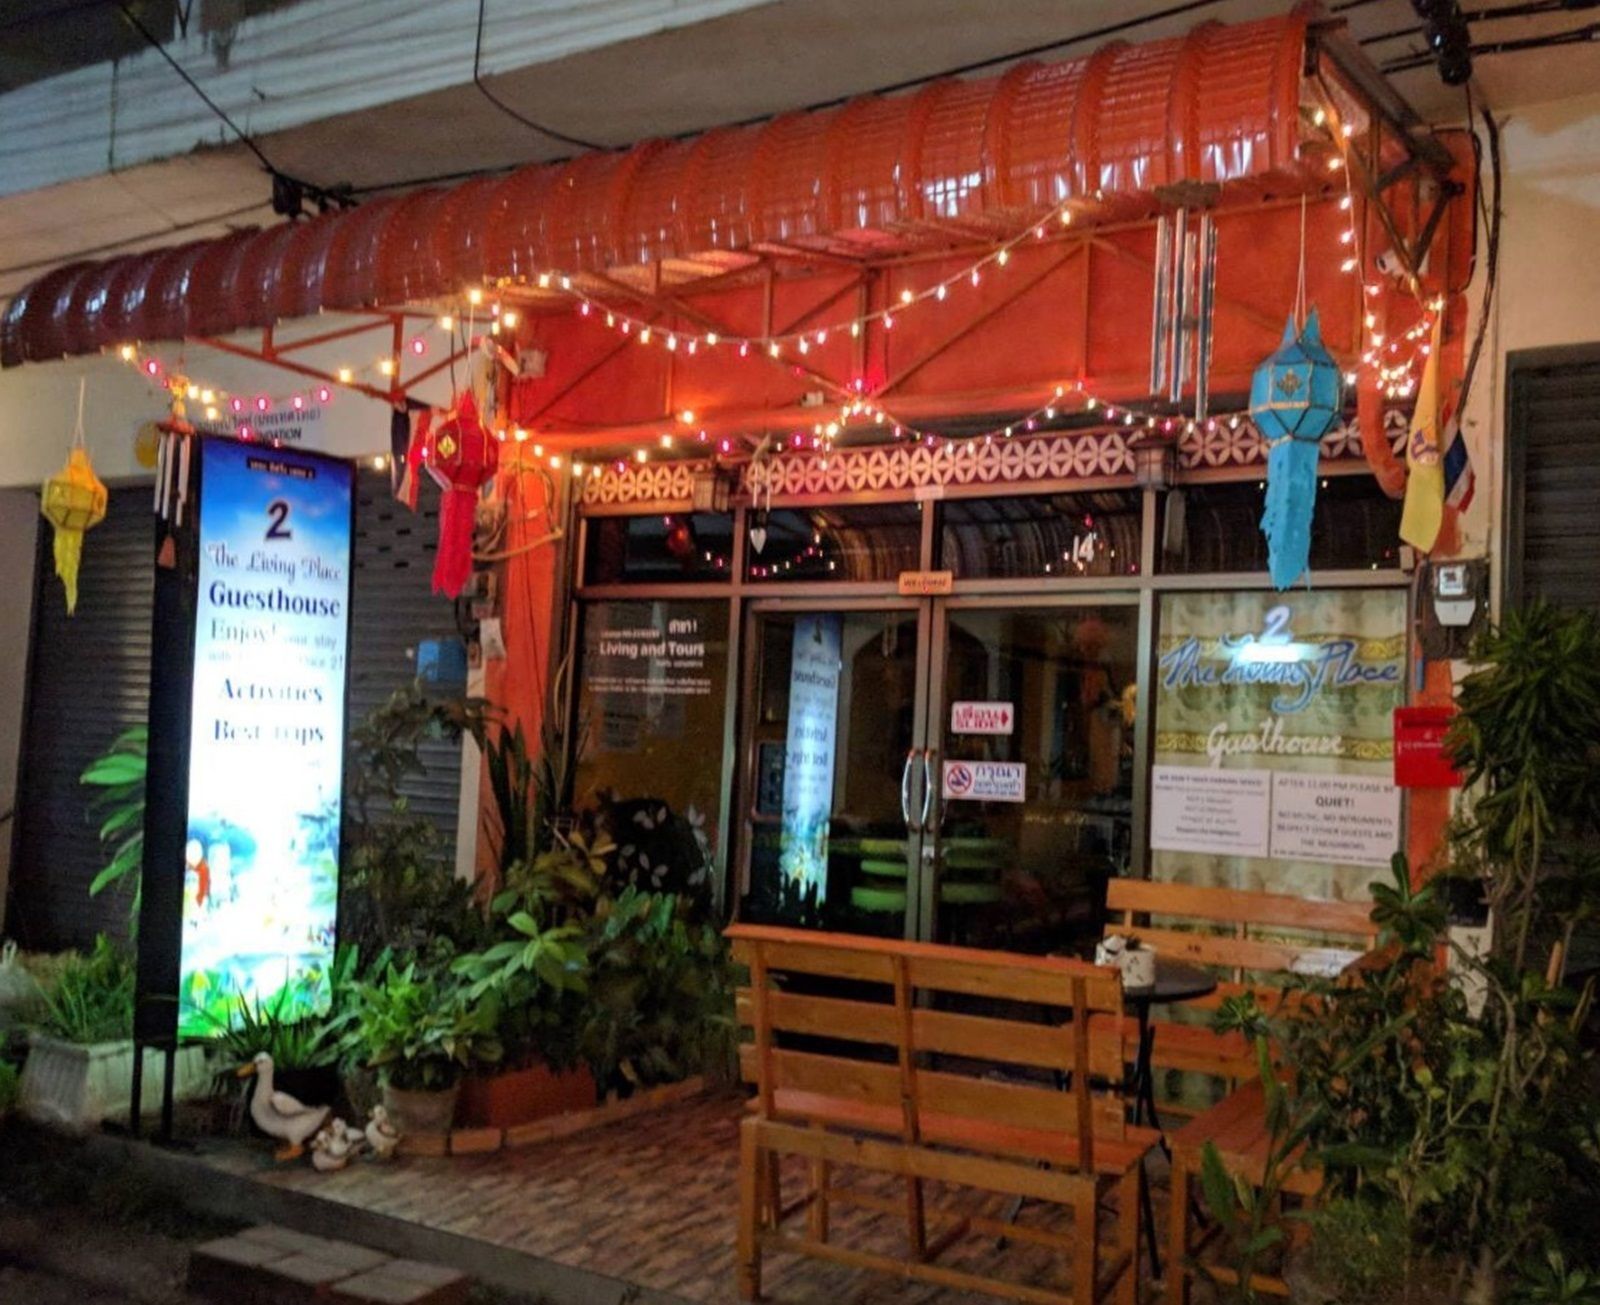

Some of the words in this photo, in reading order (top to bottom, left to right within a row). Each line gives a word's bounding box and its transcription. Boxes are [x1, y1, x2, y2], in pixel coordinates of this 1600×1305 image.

[265, 500, 291, 541] 2
[208, 544, 238, 568] The
[245, 552, 296, 582] Living
[299, 559, 341, 582] Place
[209, 580, 340, 617] Guesthouse
[1261, 605, 1292, 644] 2
[600, 642, 637, 660] Living
[640, 641, 665, 657] and
[668, 641, 705, 657] Tours
[1158, 634, 1217, 689] The
[1312, 639, 1400, 693] Place
[218, 677, 323, 702] Activities
[1315, 795, 1355, 808] QUIET!
